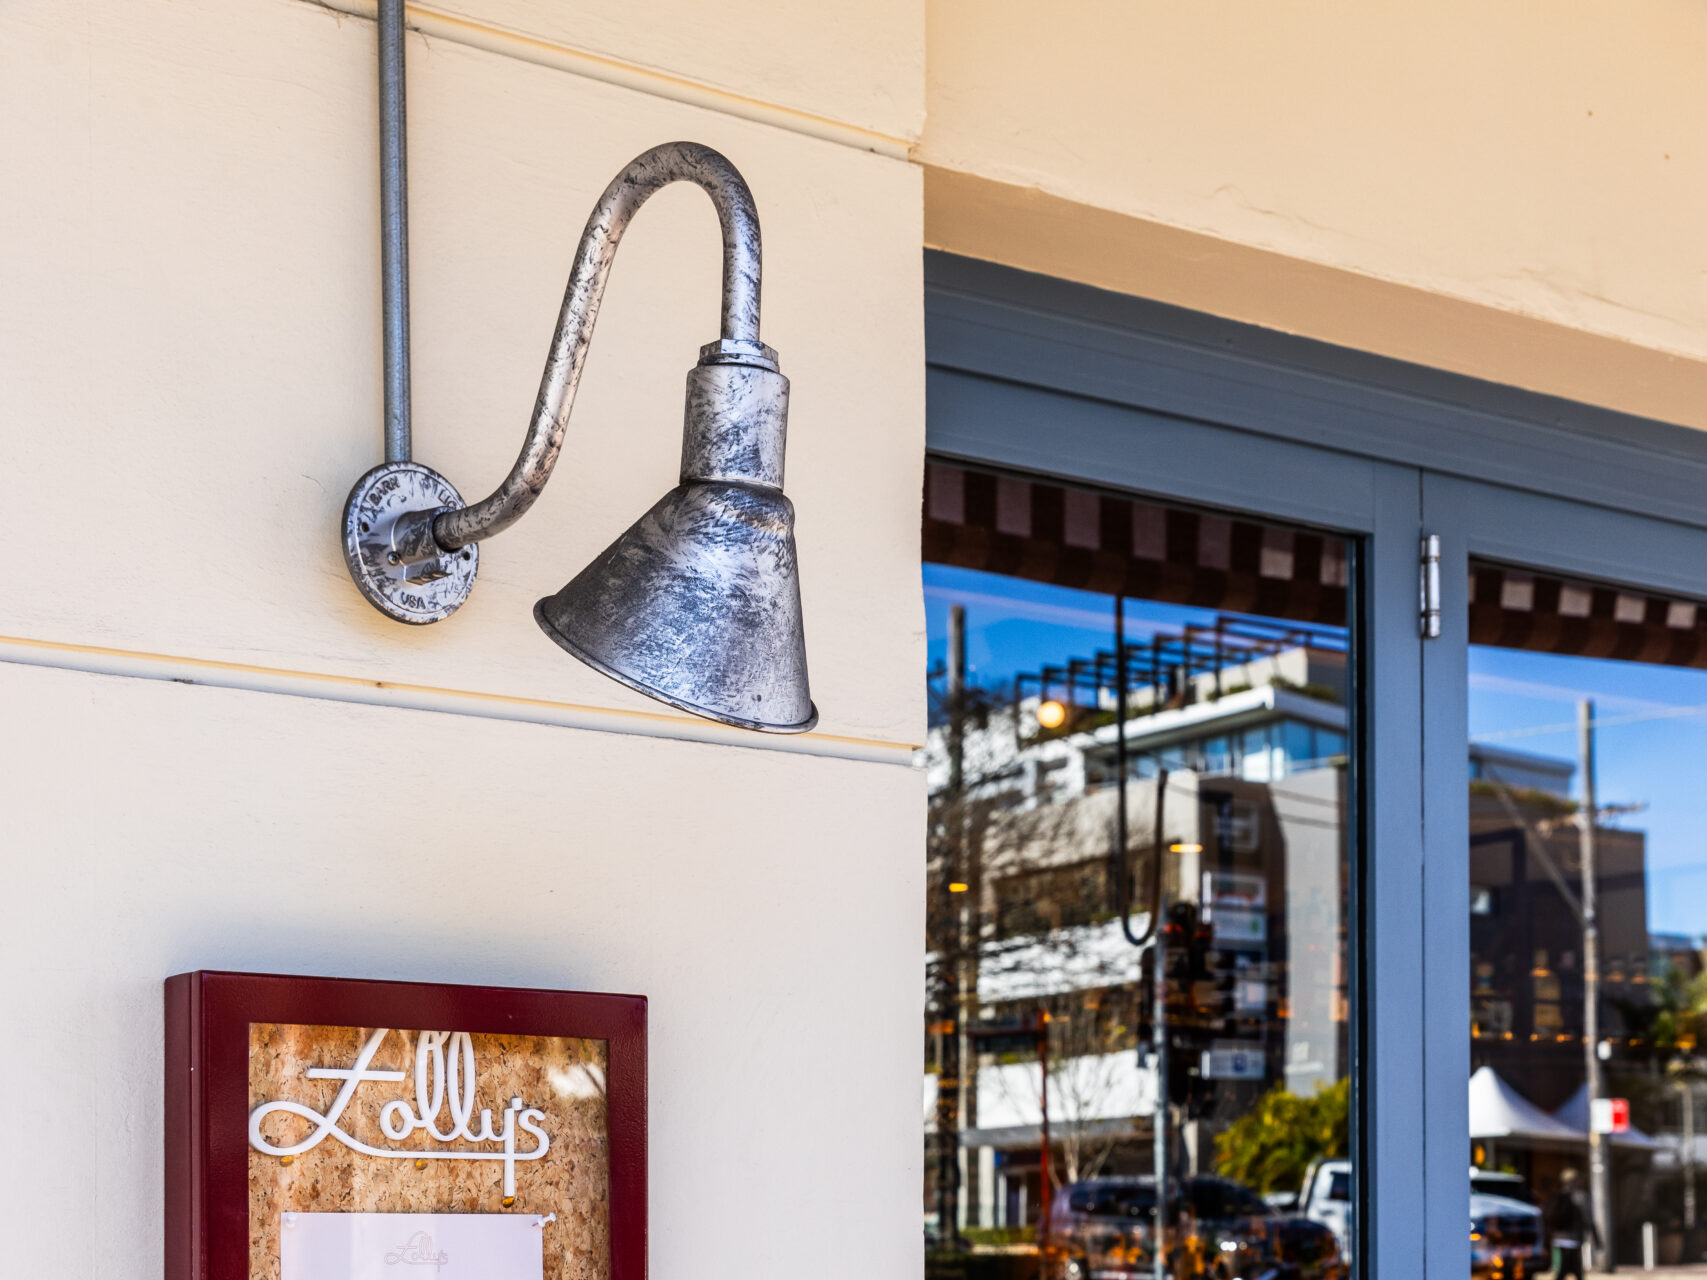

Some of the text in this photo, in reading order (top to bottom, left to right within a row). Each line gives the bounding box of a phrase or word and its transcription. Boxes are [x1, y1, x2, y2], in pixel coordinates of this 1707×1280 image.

[369, 476, 400, 507] BARN
[401, 592, 427, 610] USA
[250, 1028, 550, 1197] Lolly's
